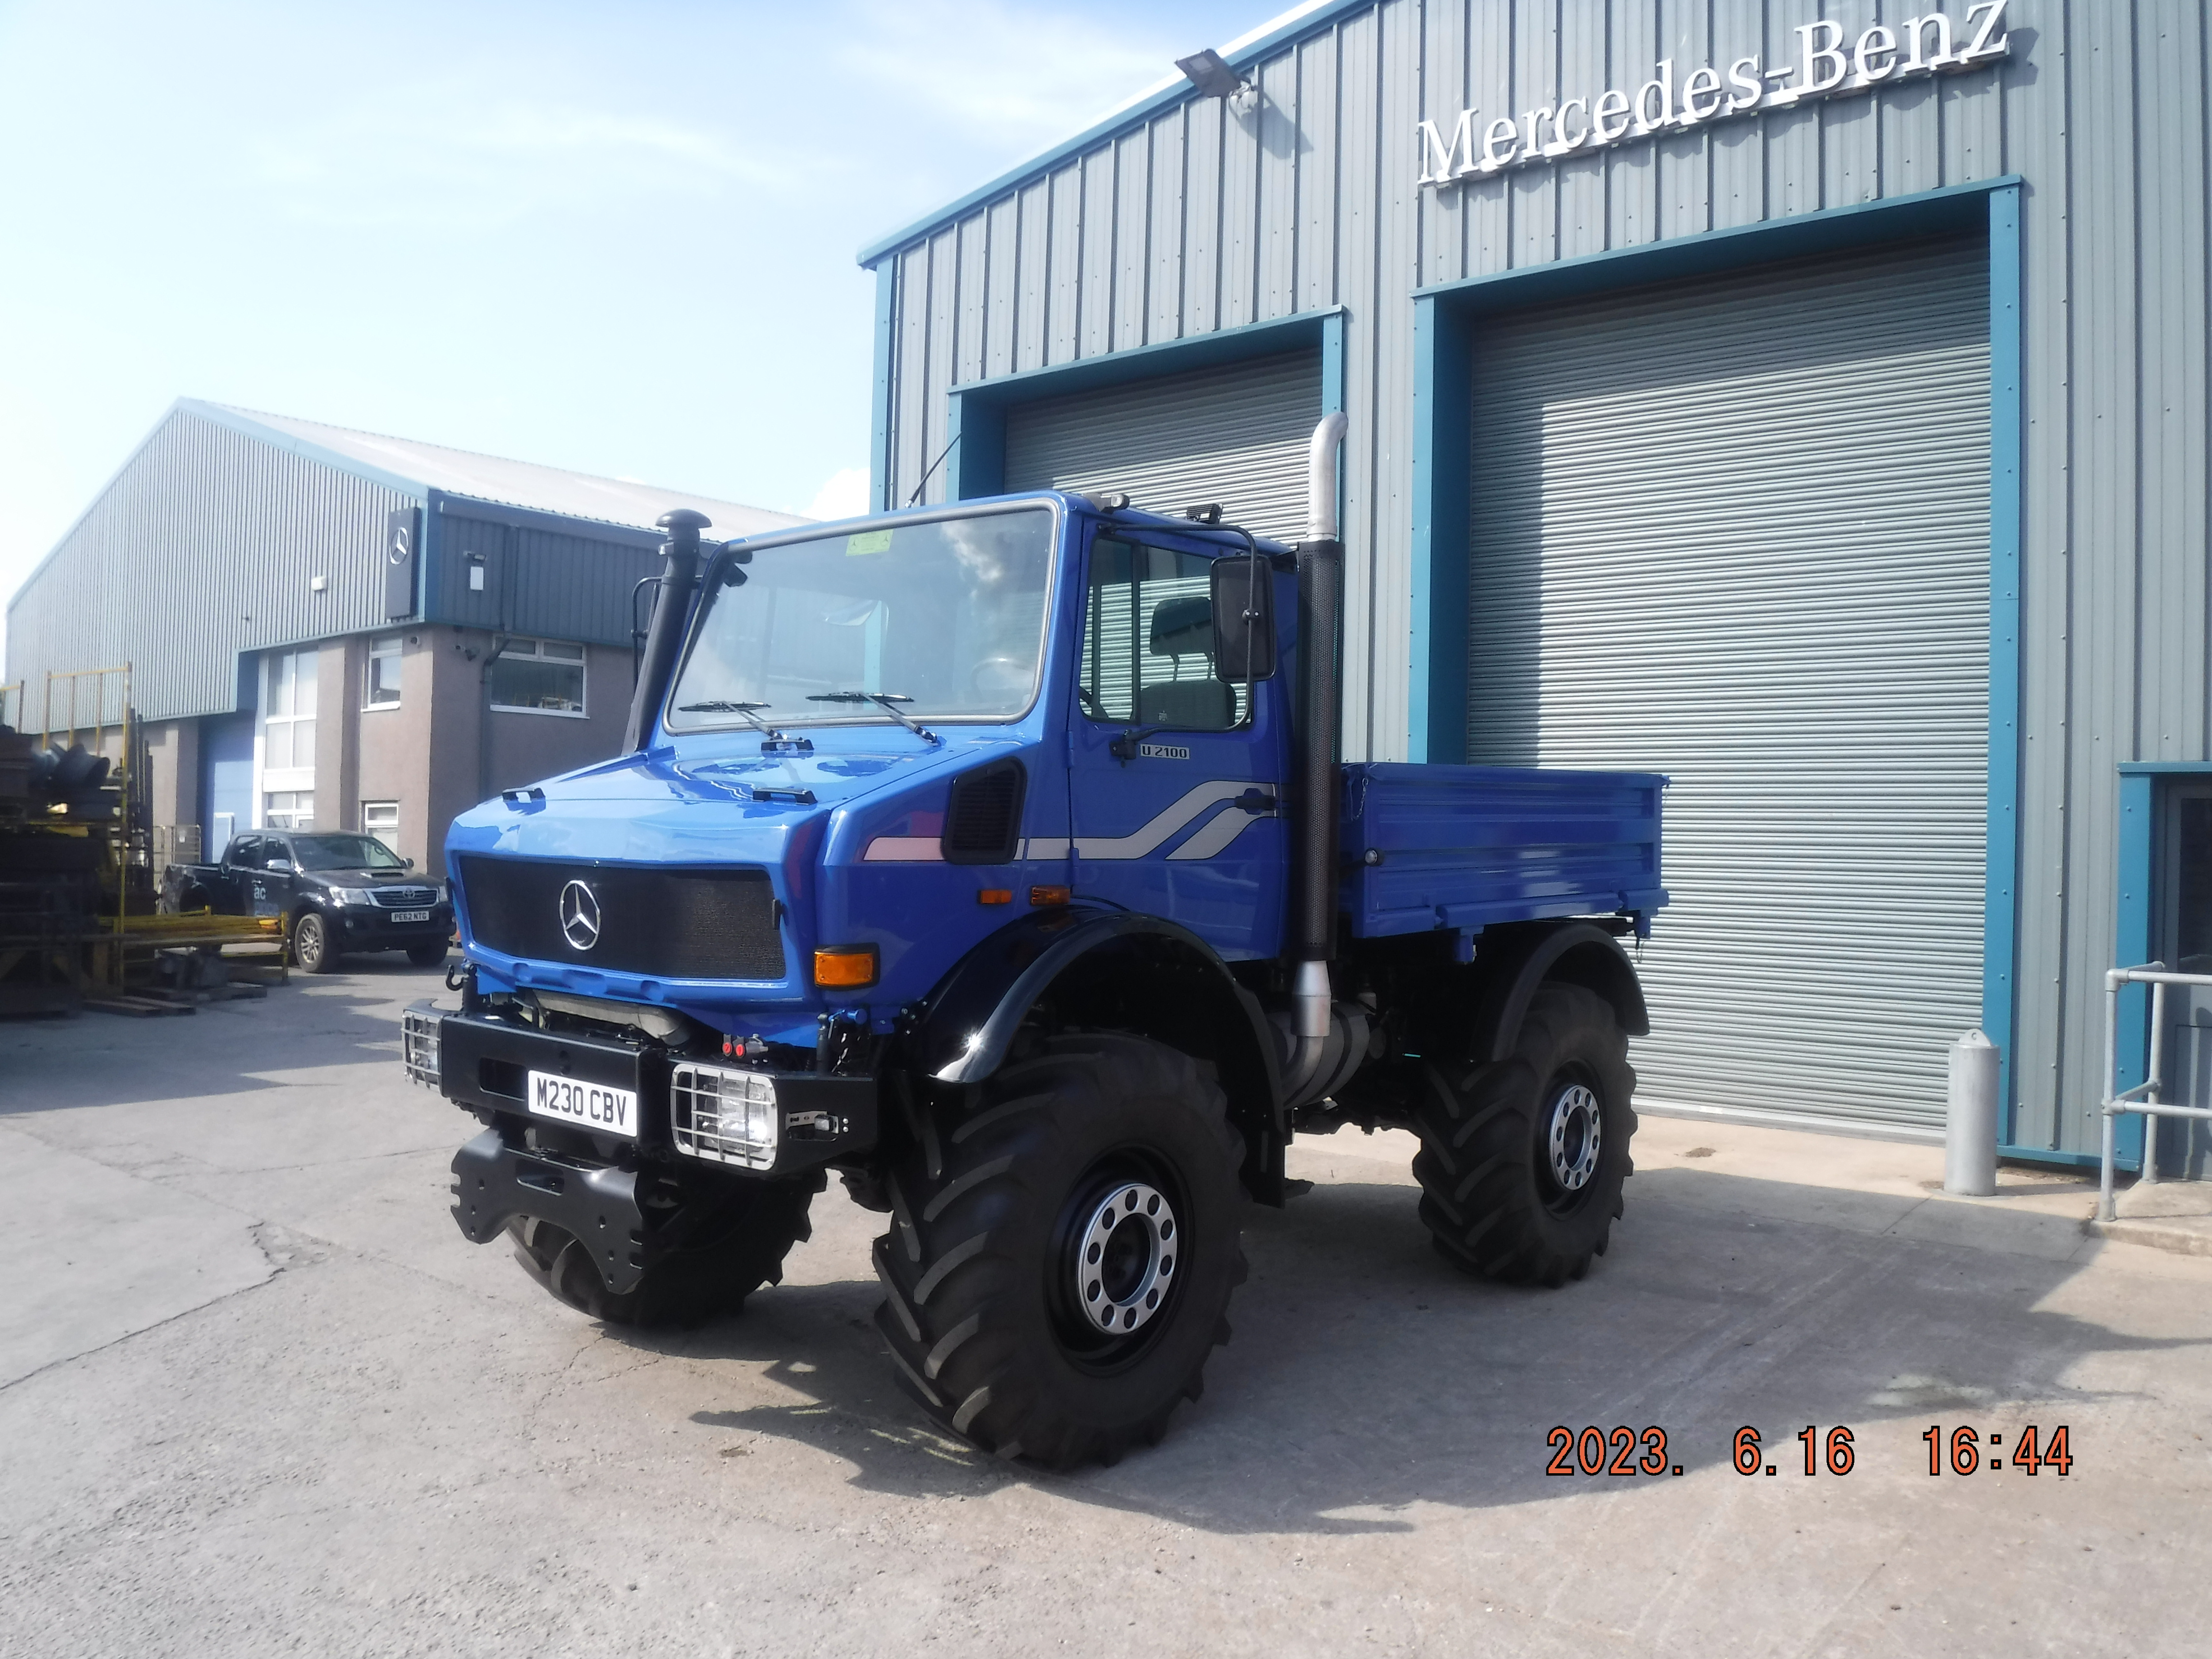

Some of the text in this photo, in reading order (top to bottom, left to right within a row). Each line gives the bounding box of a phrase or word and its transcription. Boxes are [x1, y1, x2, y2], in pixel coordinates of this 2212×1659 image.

[1417, 0, 2008, 183] Mercedes-Benz
[1142, 745, 1187, 758] U 2100
[537, 1077, 626, 1126] M230 CBV
